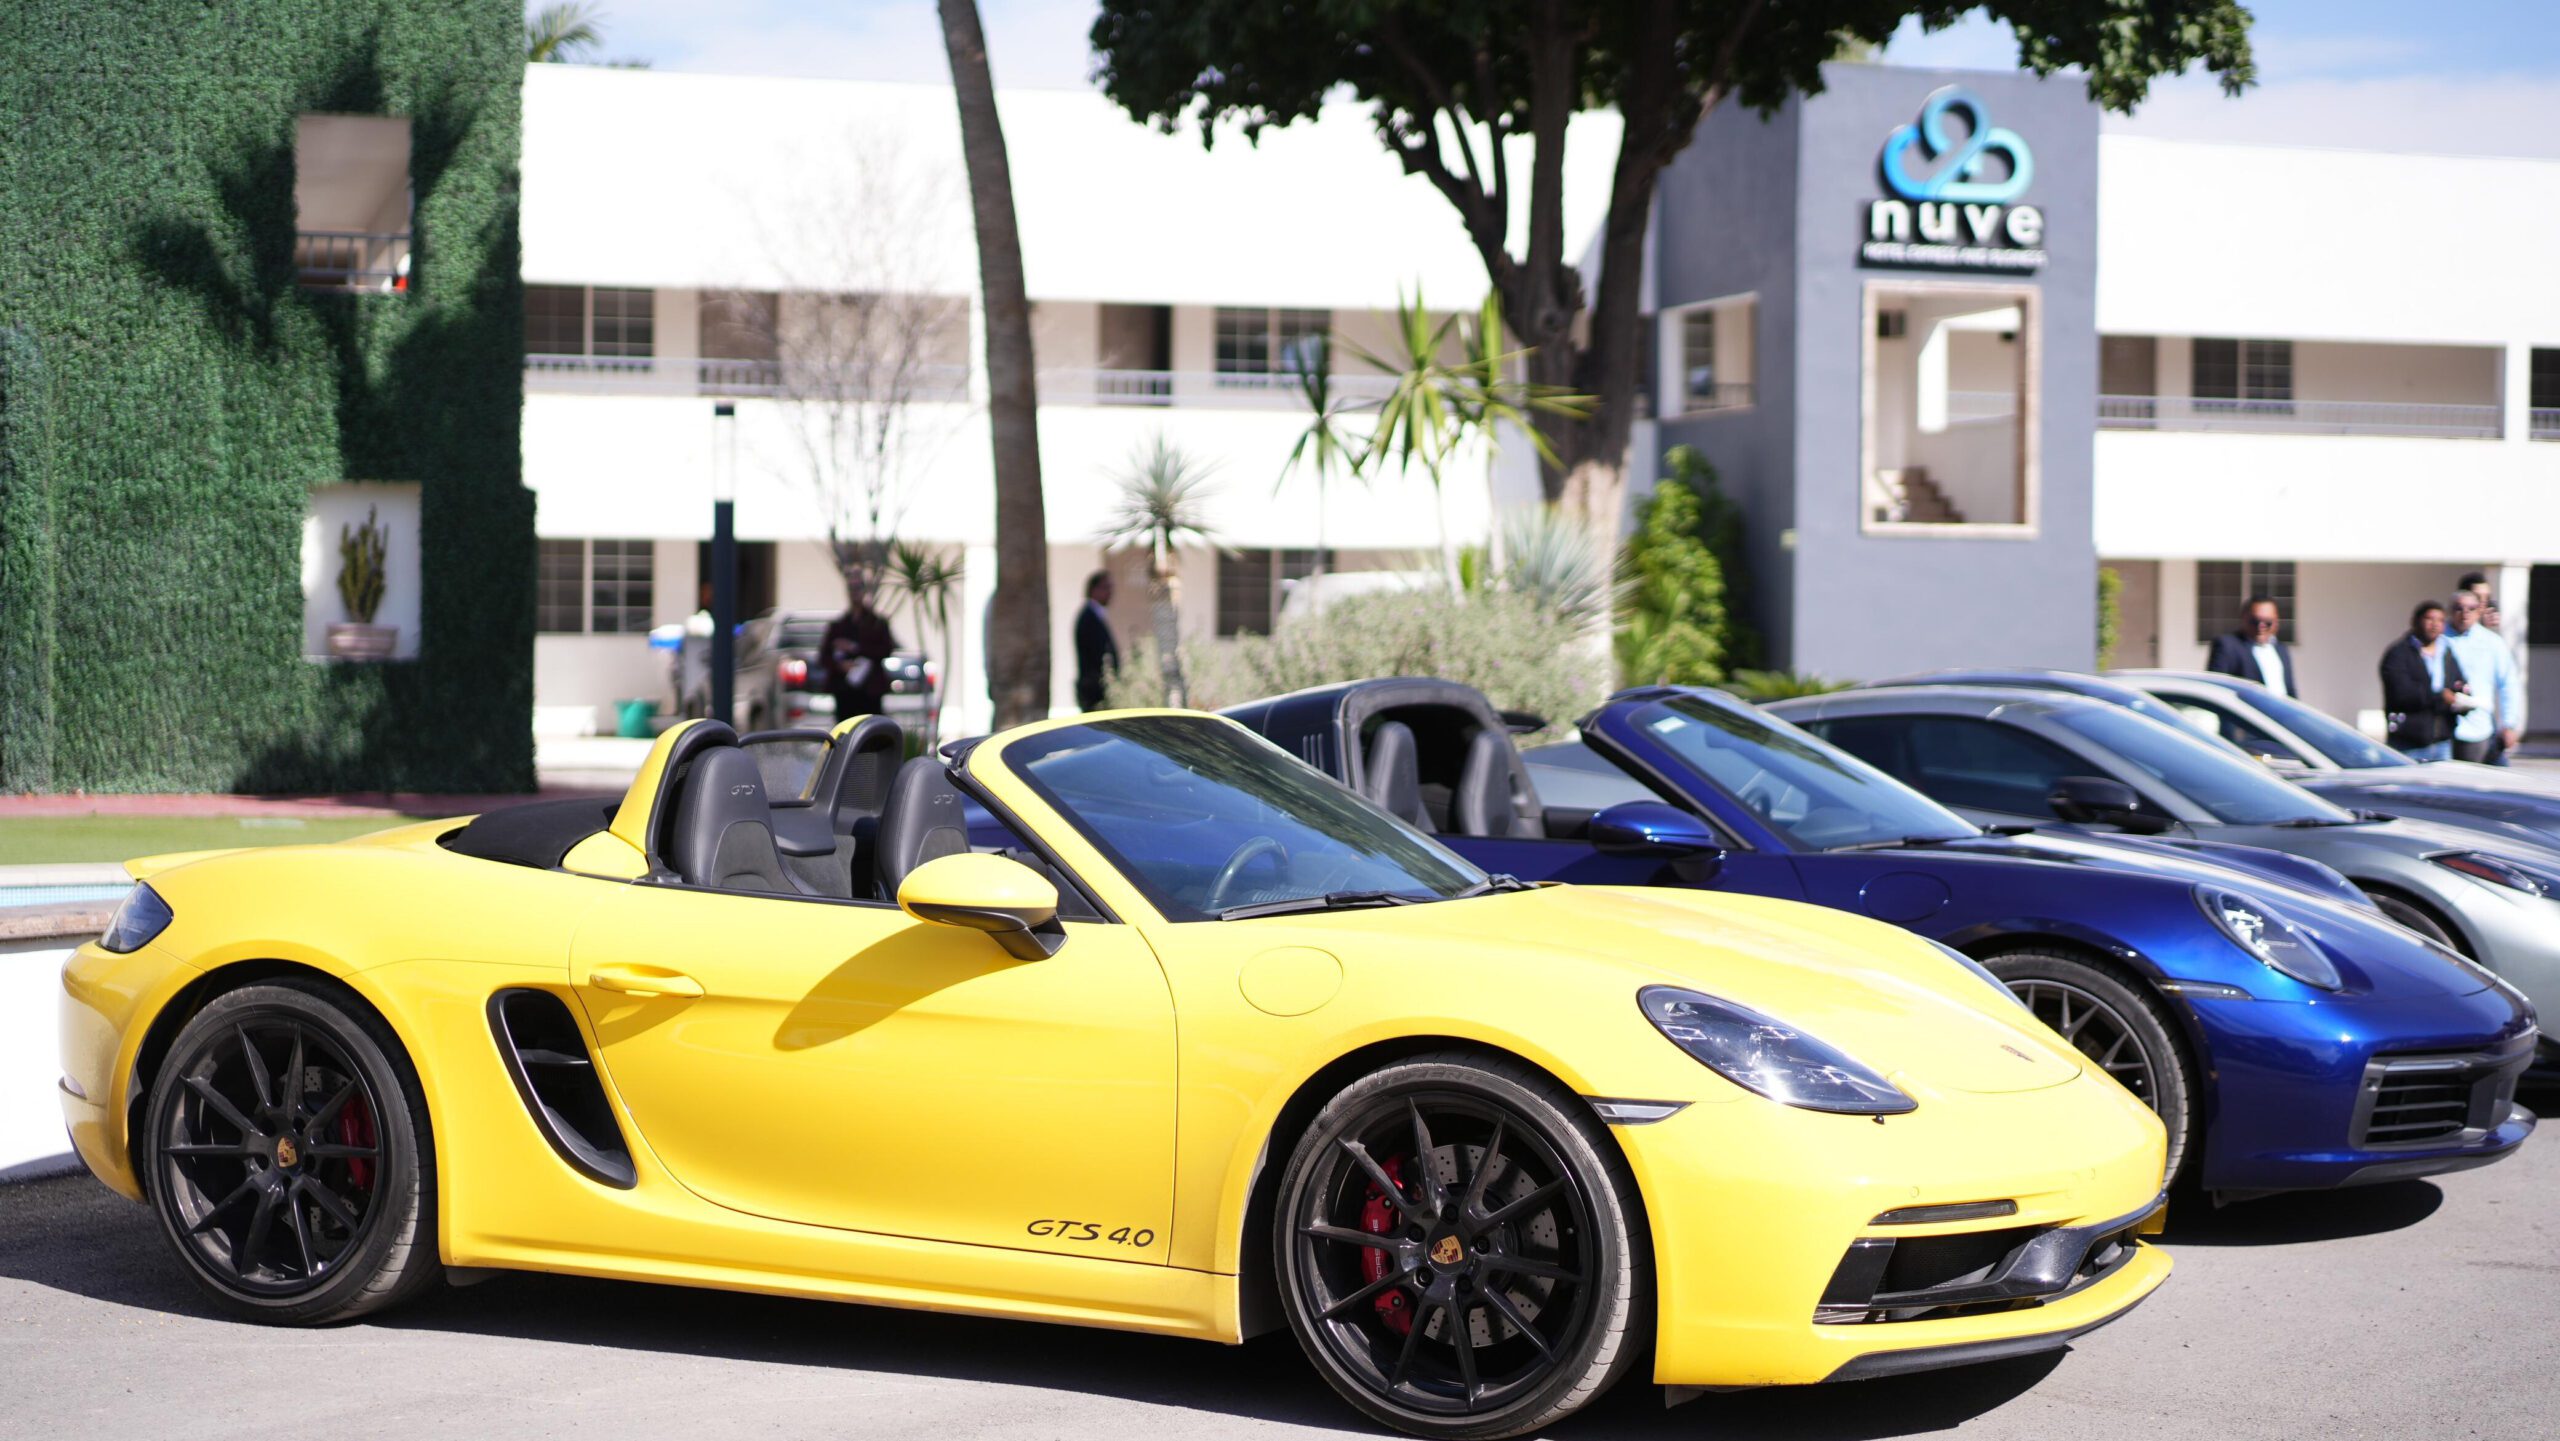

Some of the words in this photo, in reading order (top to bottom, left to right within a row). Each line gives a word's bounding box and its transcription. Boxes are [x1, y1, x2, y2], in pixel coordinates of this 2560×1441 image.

[1871, 200, 2044, 245] nuve
[1027, 1219, 1102, 1241] GTS
[1107, 1226, 1155, 1248] 4.0
[1373, 1218, 1382, 1280] ORSE
